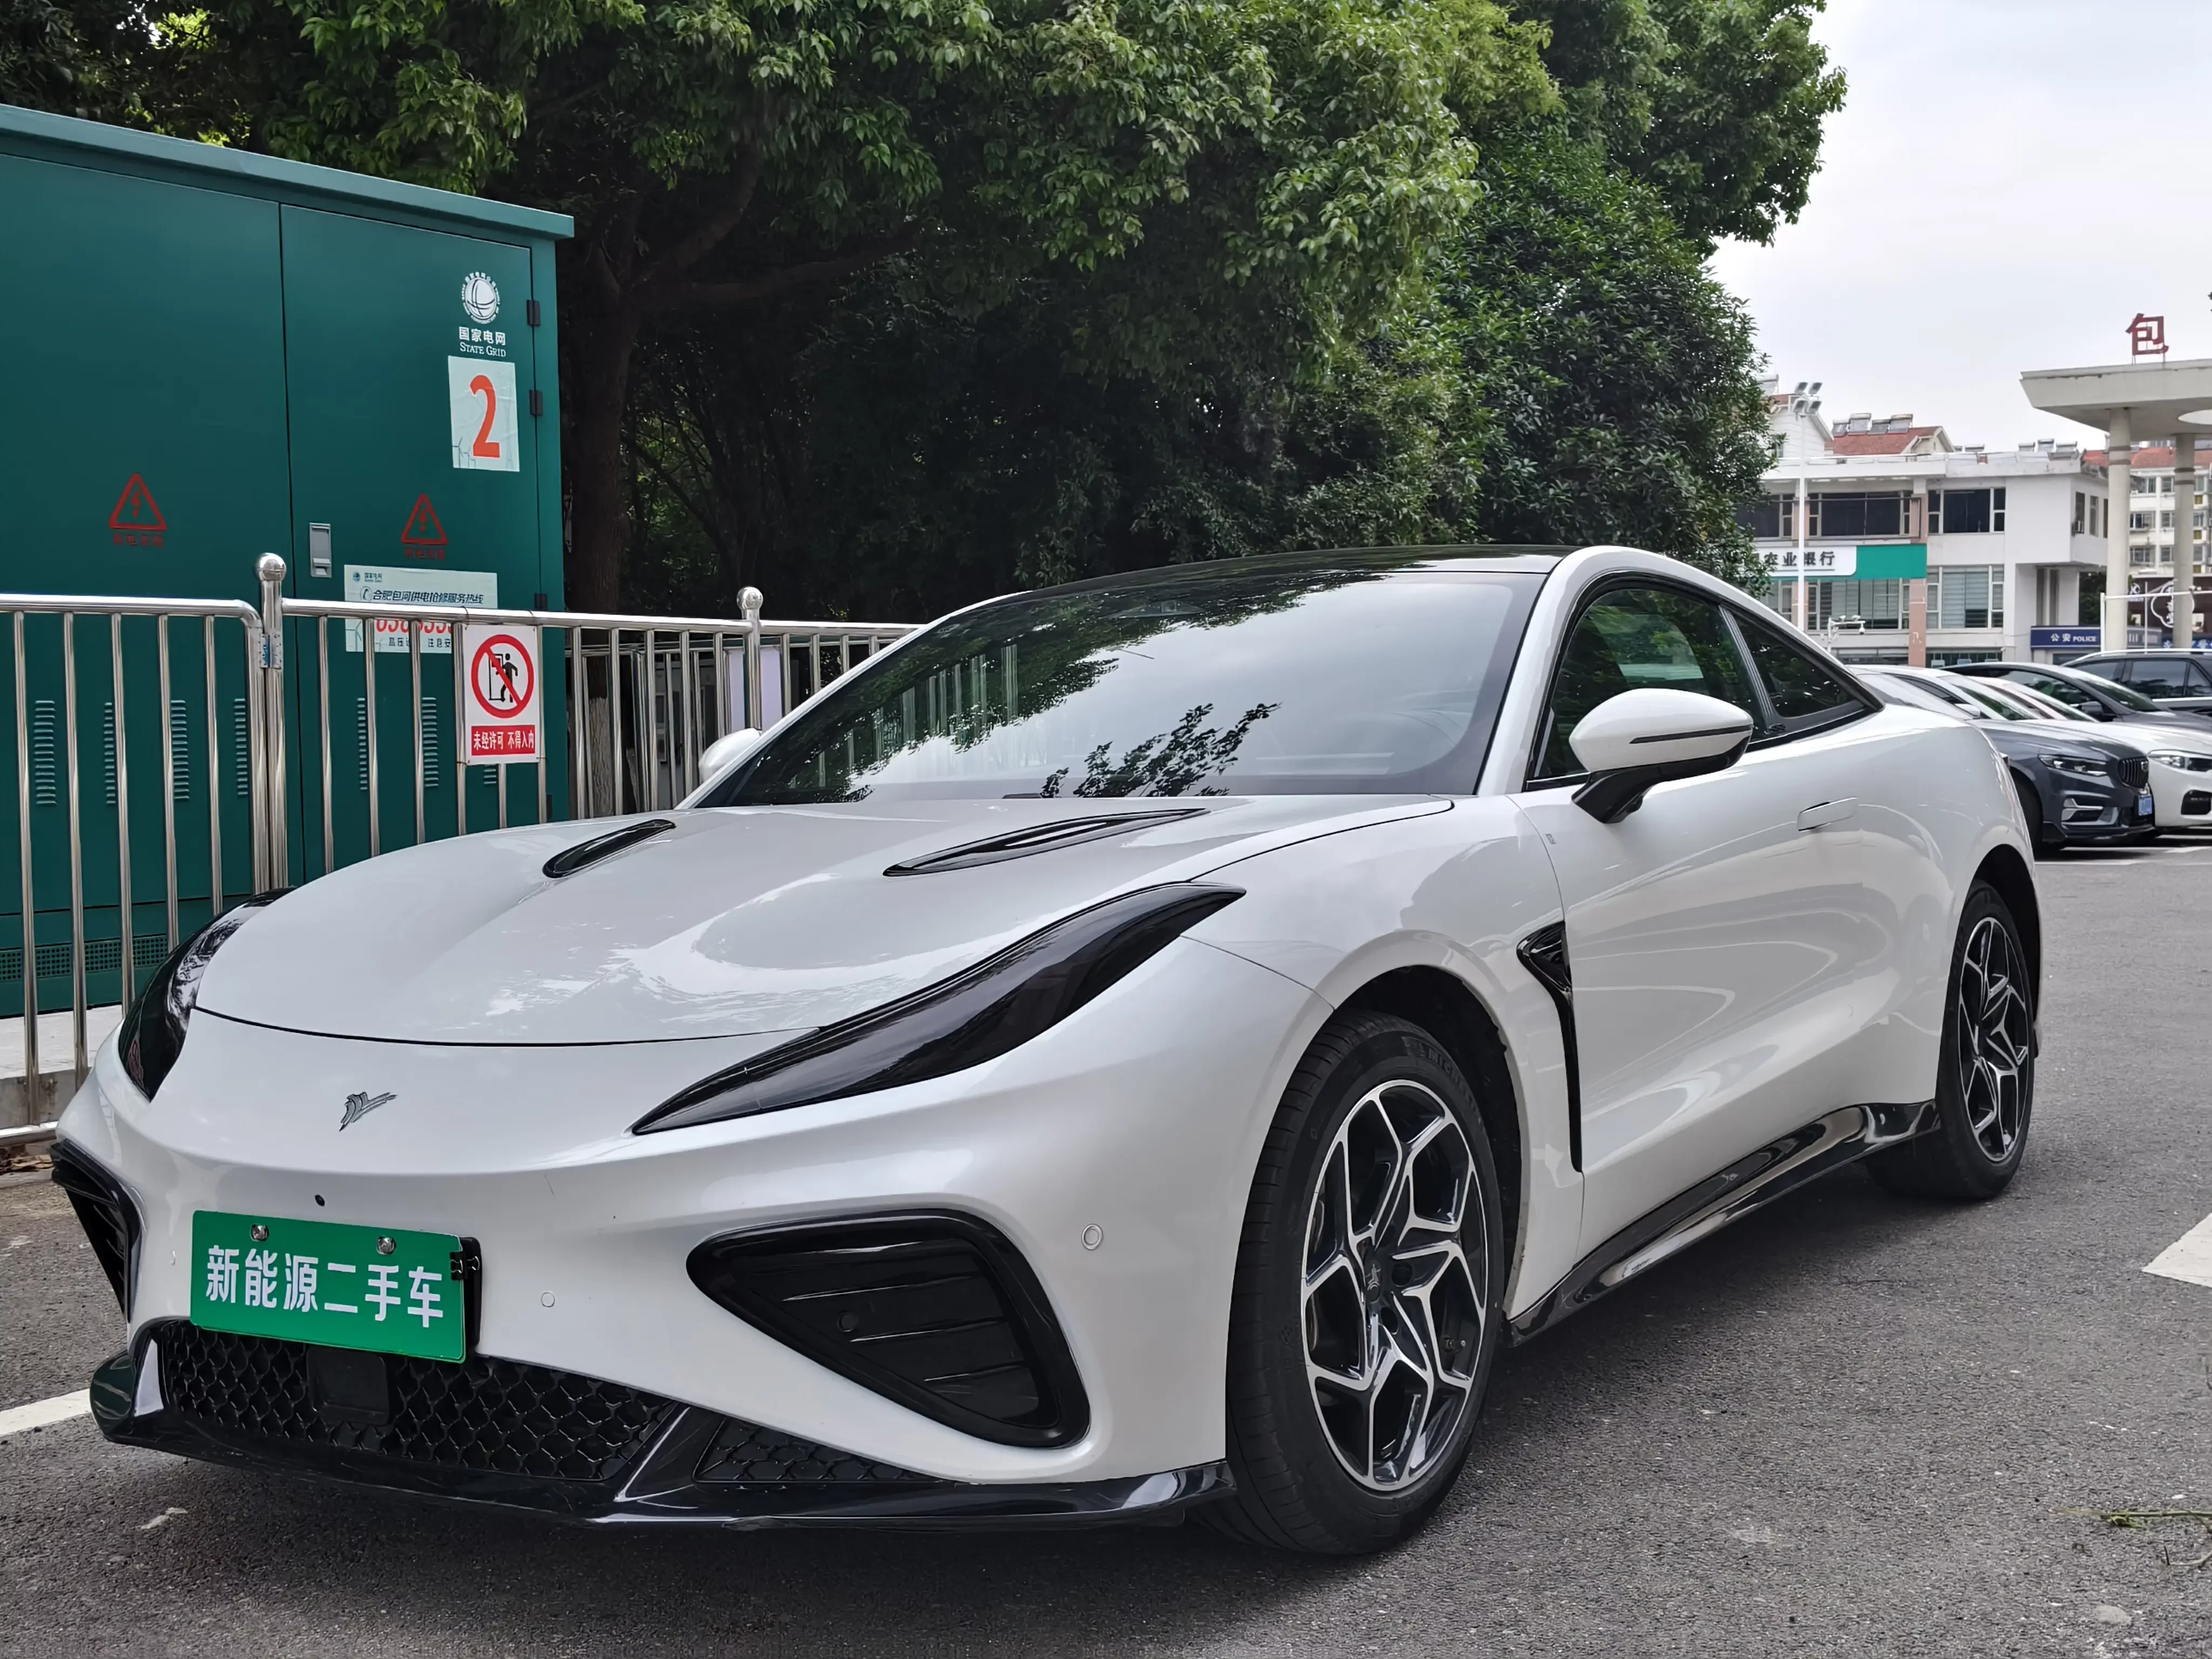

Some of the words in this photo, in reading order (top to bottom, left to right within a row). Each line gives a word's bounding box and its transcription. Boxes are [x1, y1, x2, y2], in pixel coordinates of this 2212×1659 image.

[459, 326, 506, 346] 国家电网
[460, 342, 484, 355] STATE
[486, 346, 506, 357] GRID
[2125, 313, 2169, 355] 包
[469, 374, 500, 459] 2
[474, 731, 503, 750] 未经许可
[508, 730, 534, 750] 不得入内
[205, 1245, 443, 1328] 新能源二手车
